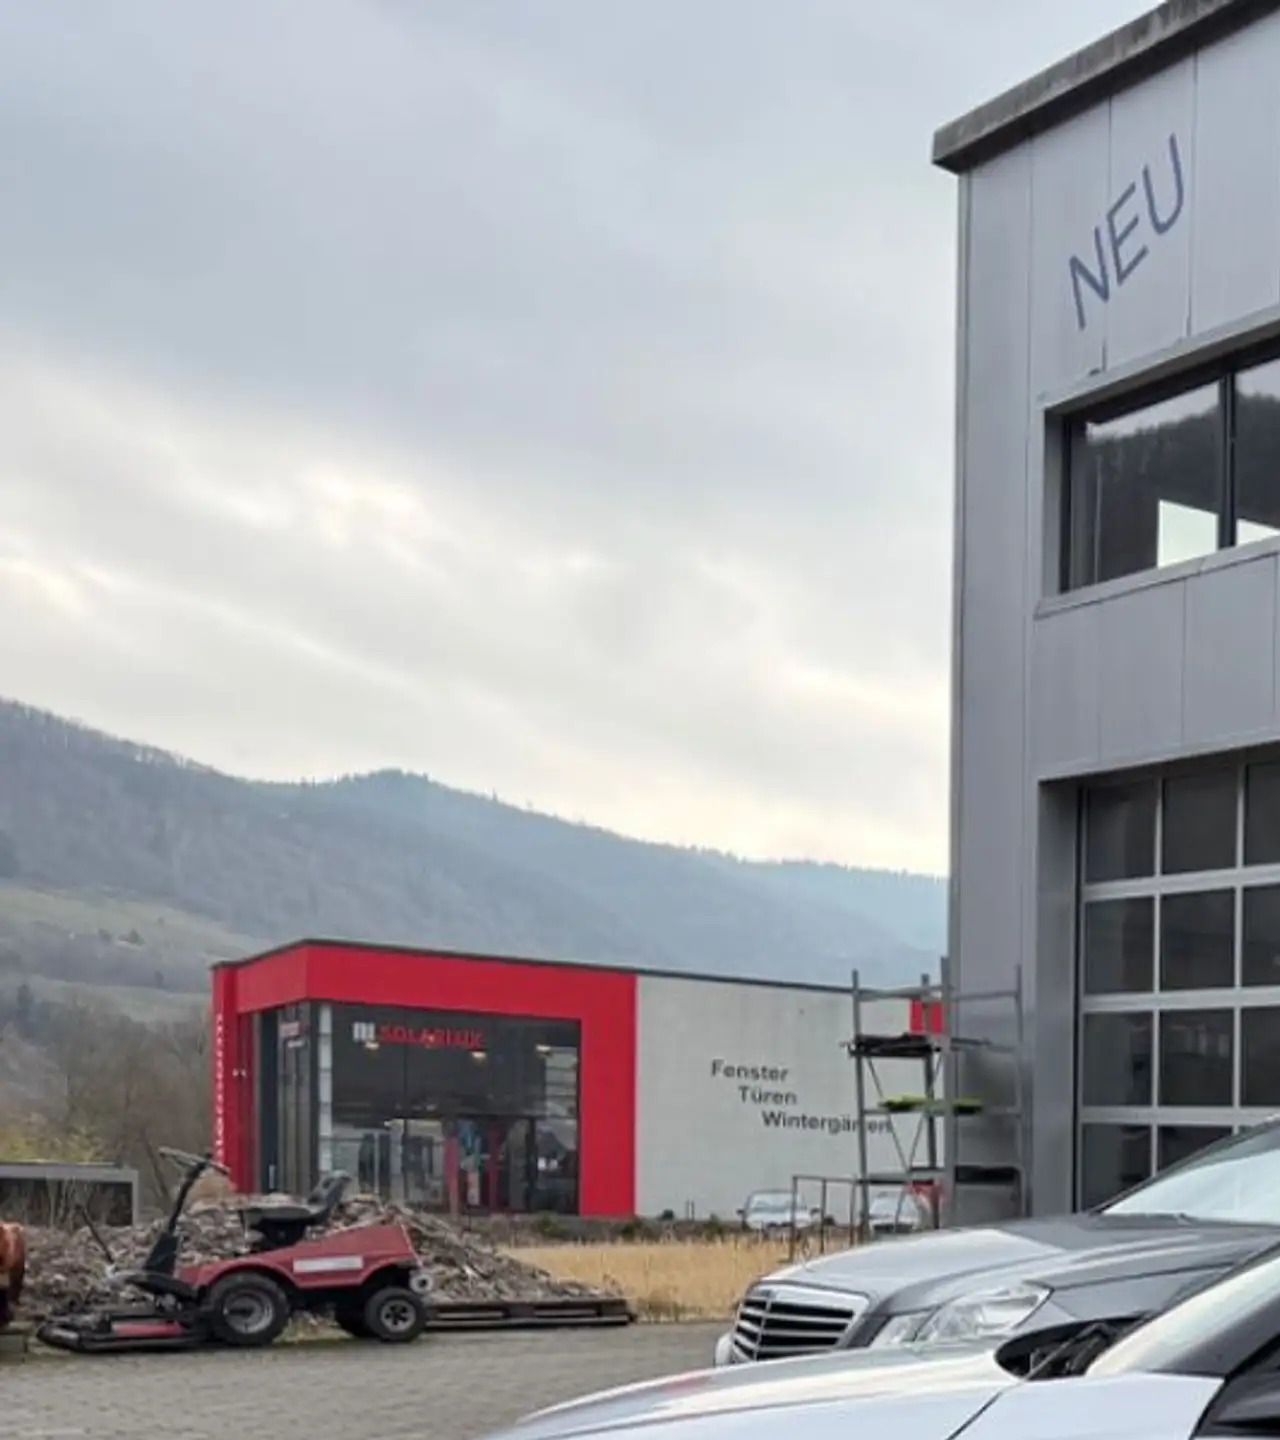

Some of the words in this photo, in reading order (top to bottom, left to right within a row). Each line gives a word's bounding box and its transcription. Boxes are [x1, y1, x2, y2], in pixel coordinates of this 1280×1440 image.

[1068, 132, 1185, 332] NEU
[711, 1058, 790, 1082] Fenster
[738, 1085, 799, 1106] Türen
[762, 1110, 893, 1135] Wintergären
